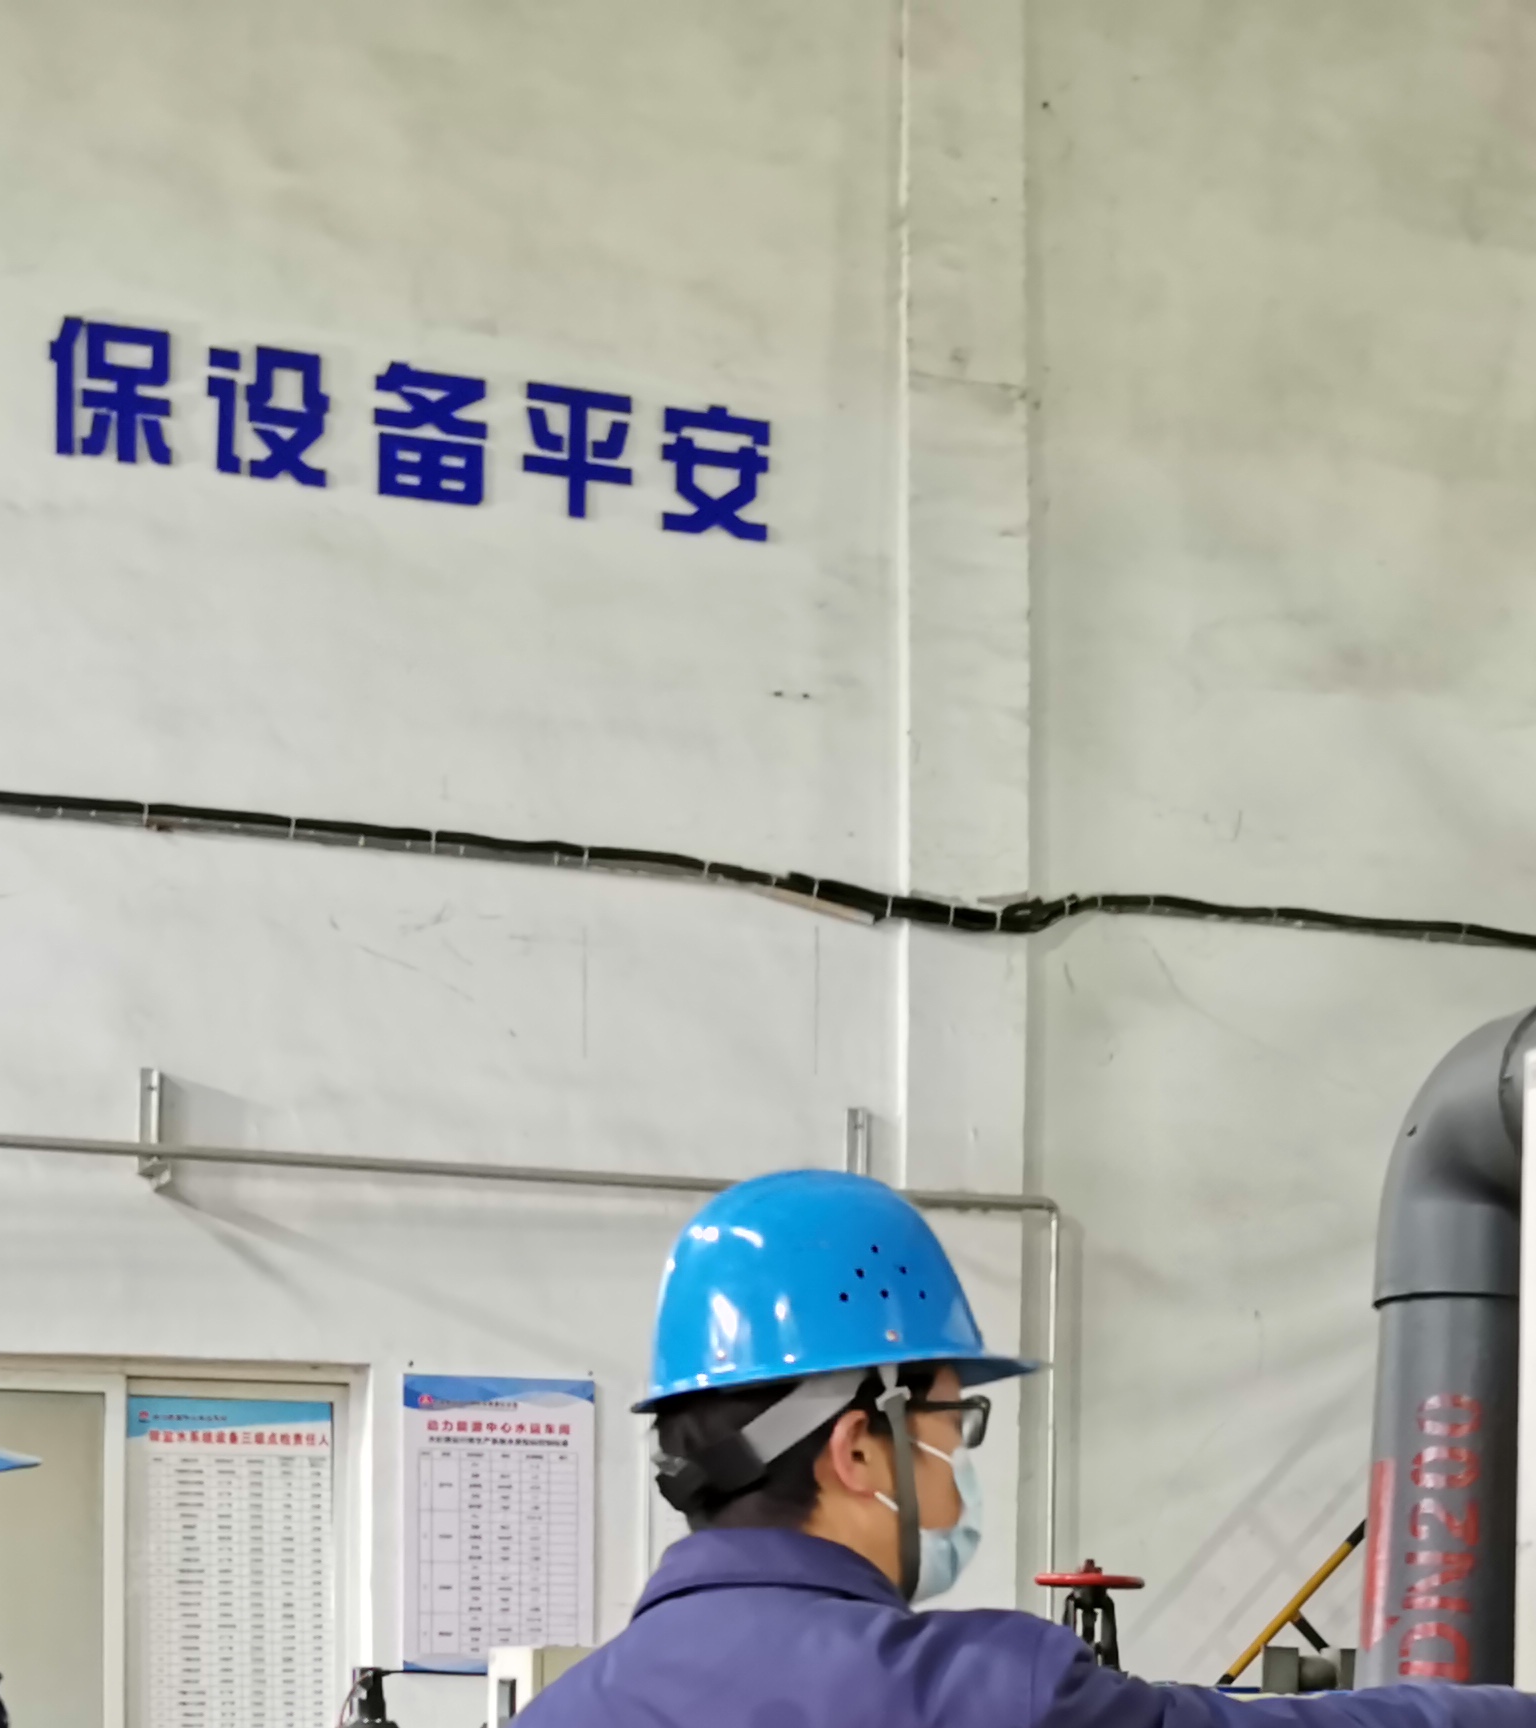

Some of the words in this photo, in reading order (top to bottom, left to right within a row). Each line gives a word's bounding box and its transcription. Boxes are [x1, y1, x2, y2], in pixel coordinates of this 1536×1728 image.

[48, 316, 771, 542] 保设备平安
[1398, 1393, 1482, 1682] DN200
